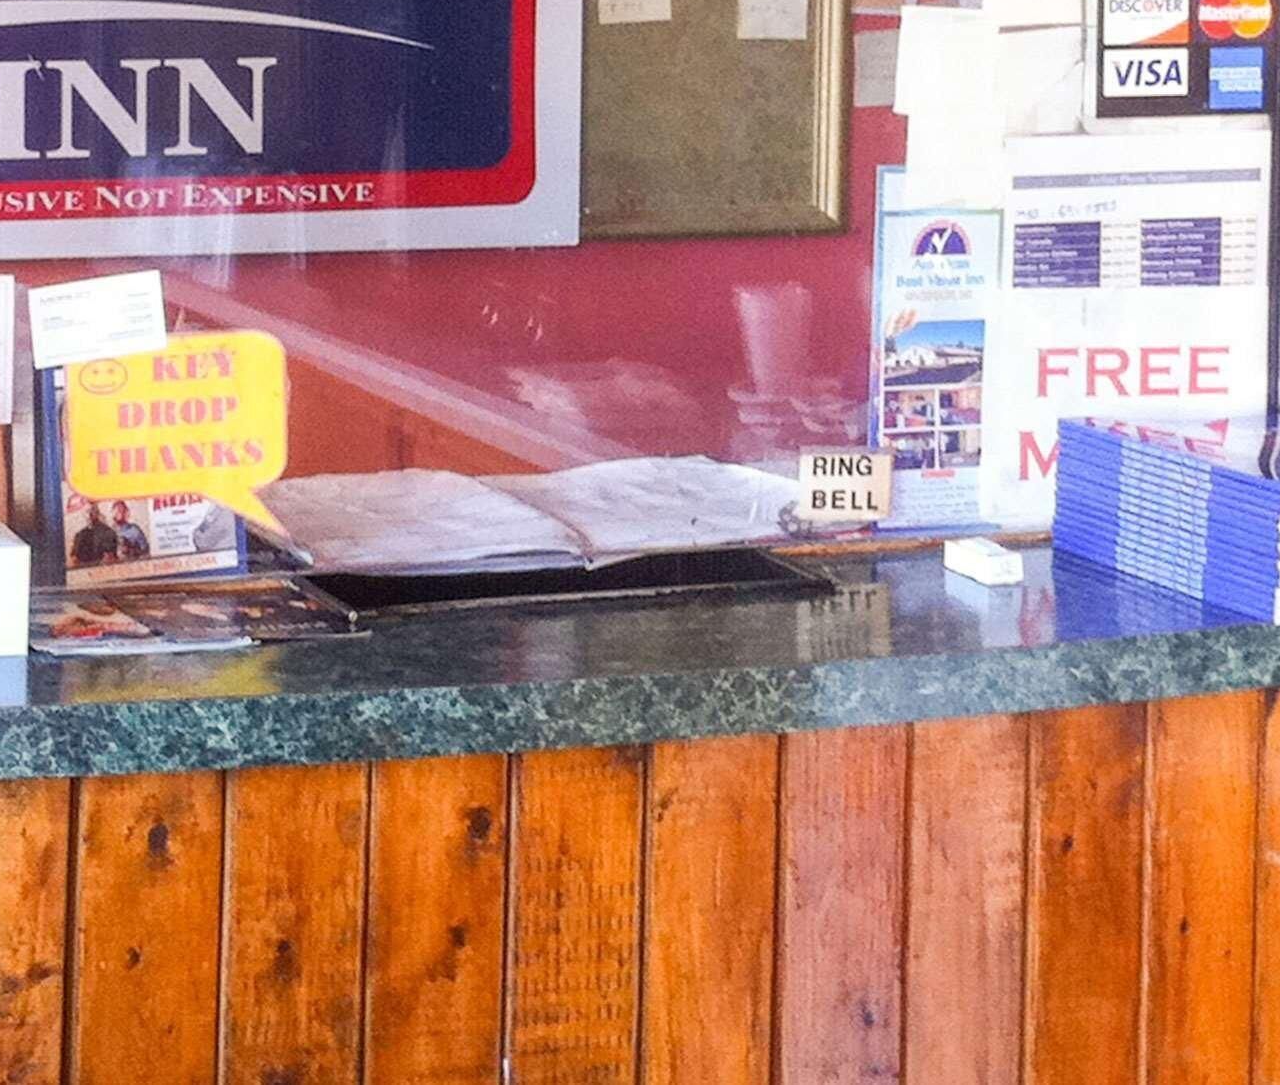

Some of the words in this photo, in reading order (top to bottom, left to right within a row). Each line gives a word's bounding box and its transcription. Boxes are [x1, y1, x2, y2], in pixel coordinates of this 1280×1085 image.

[1111, 58, 1183, 88] VISA
[94, 184, 177, 214] NOT
[183, 180, 376, 211] EXPENSIVE
[152, 347, 236, 382] KEY
[1036, 345, 1230, 398] FREE
[117, 395, 239, 429] DROP
[90, 438, 265, 476] THANKS
[811, 455, 873, 477] RING
[811, 489, 879, 512] BELL
